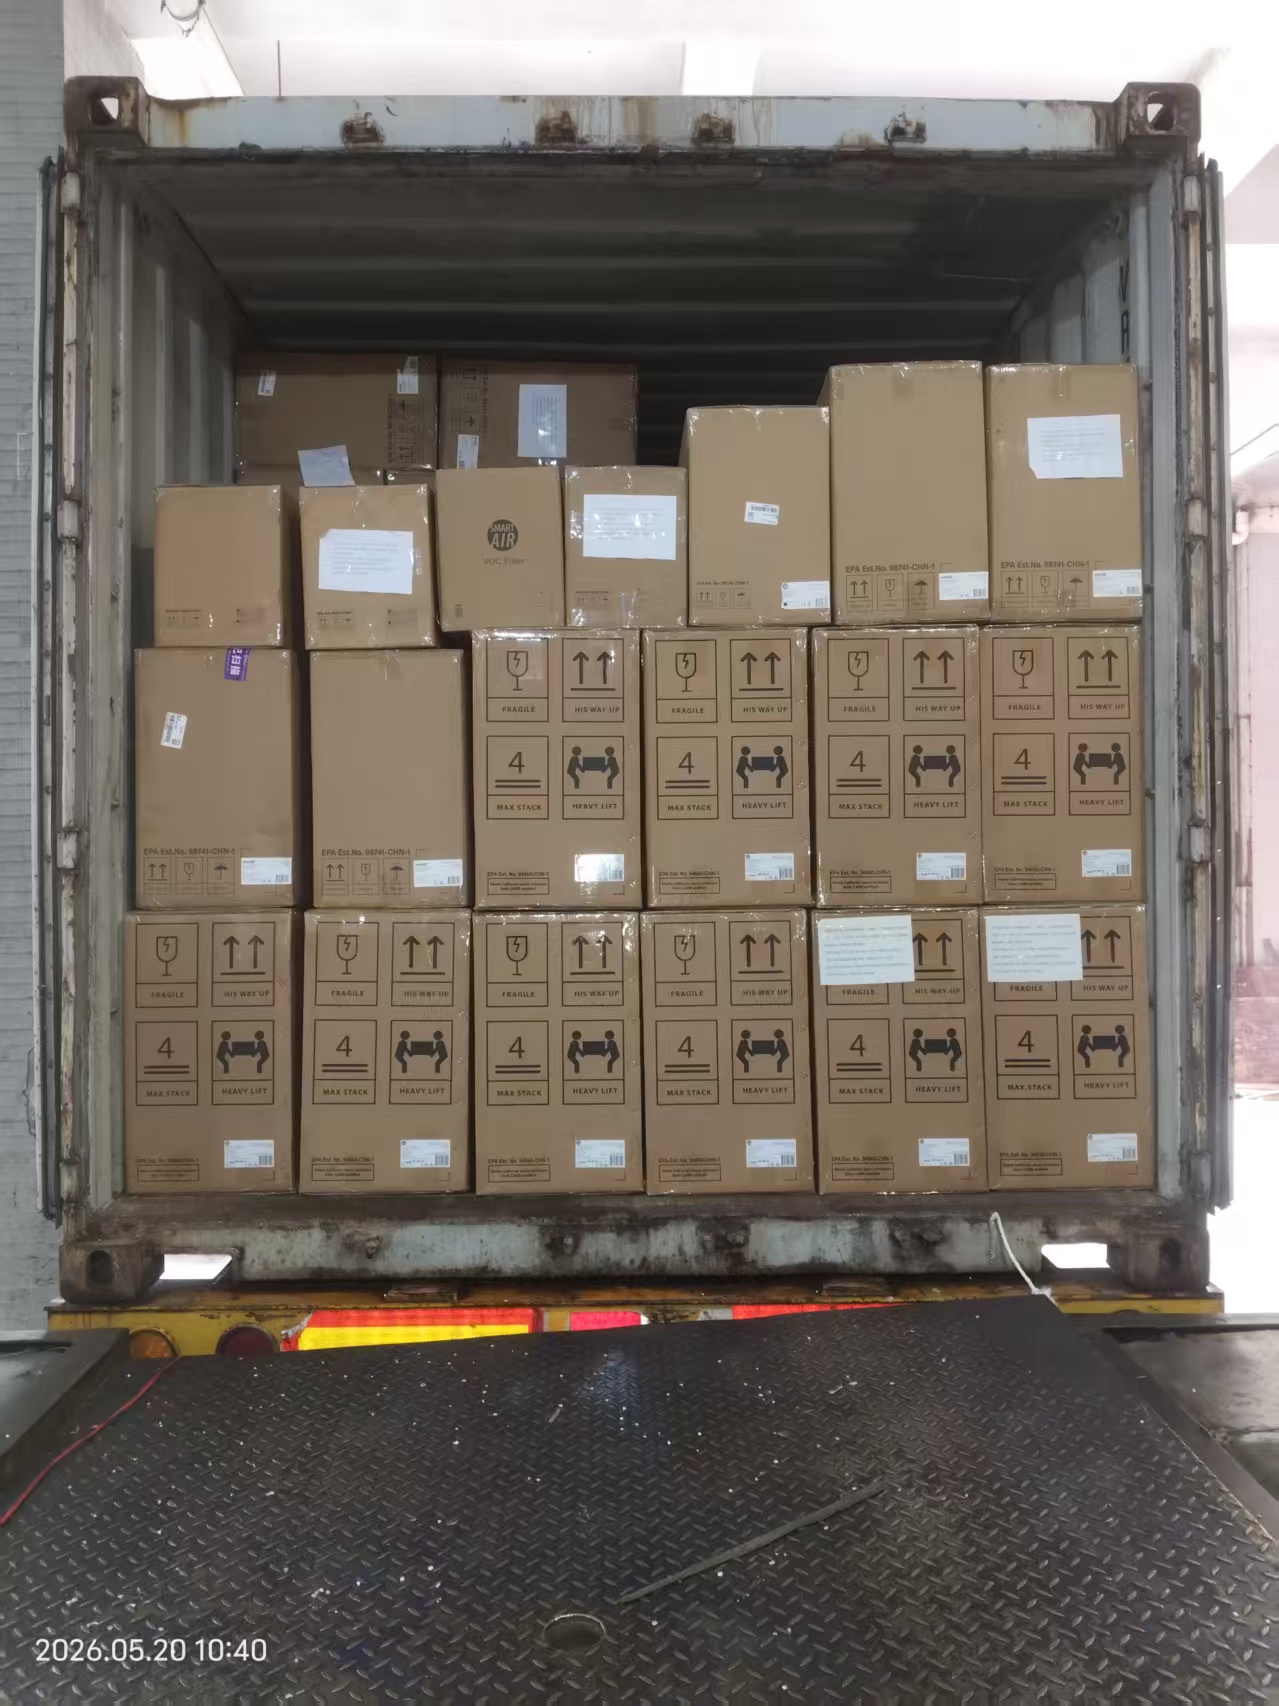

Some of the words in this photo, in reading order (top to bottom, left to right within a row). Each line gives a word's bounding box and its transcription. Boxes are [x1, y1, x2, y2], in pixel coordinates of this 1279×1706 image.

[490, 523, 516, 532] SMART
[492, 532, 516, 548] AIR
[483, 557, 502, 566] VOC
[845, 565, 860, 573] EPA
[507, 751, 525, 774] 4
[677, 751, 695, 775] 4
[849, 750, 867, 773] 4
[1013, 748, 1032, 771] 4
[157, 1036, 174, 1060] 4
[335, 1035, 353, 1058] 4
[508, 1036, 526, 1060] 4
[677, 1035, 695, 1059] 4
[849, 1034, 866, 1057] 4
[1017, 1030, 1035, 1054] 4
